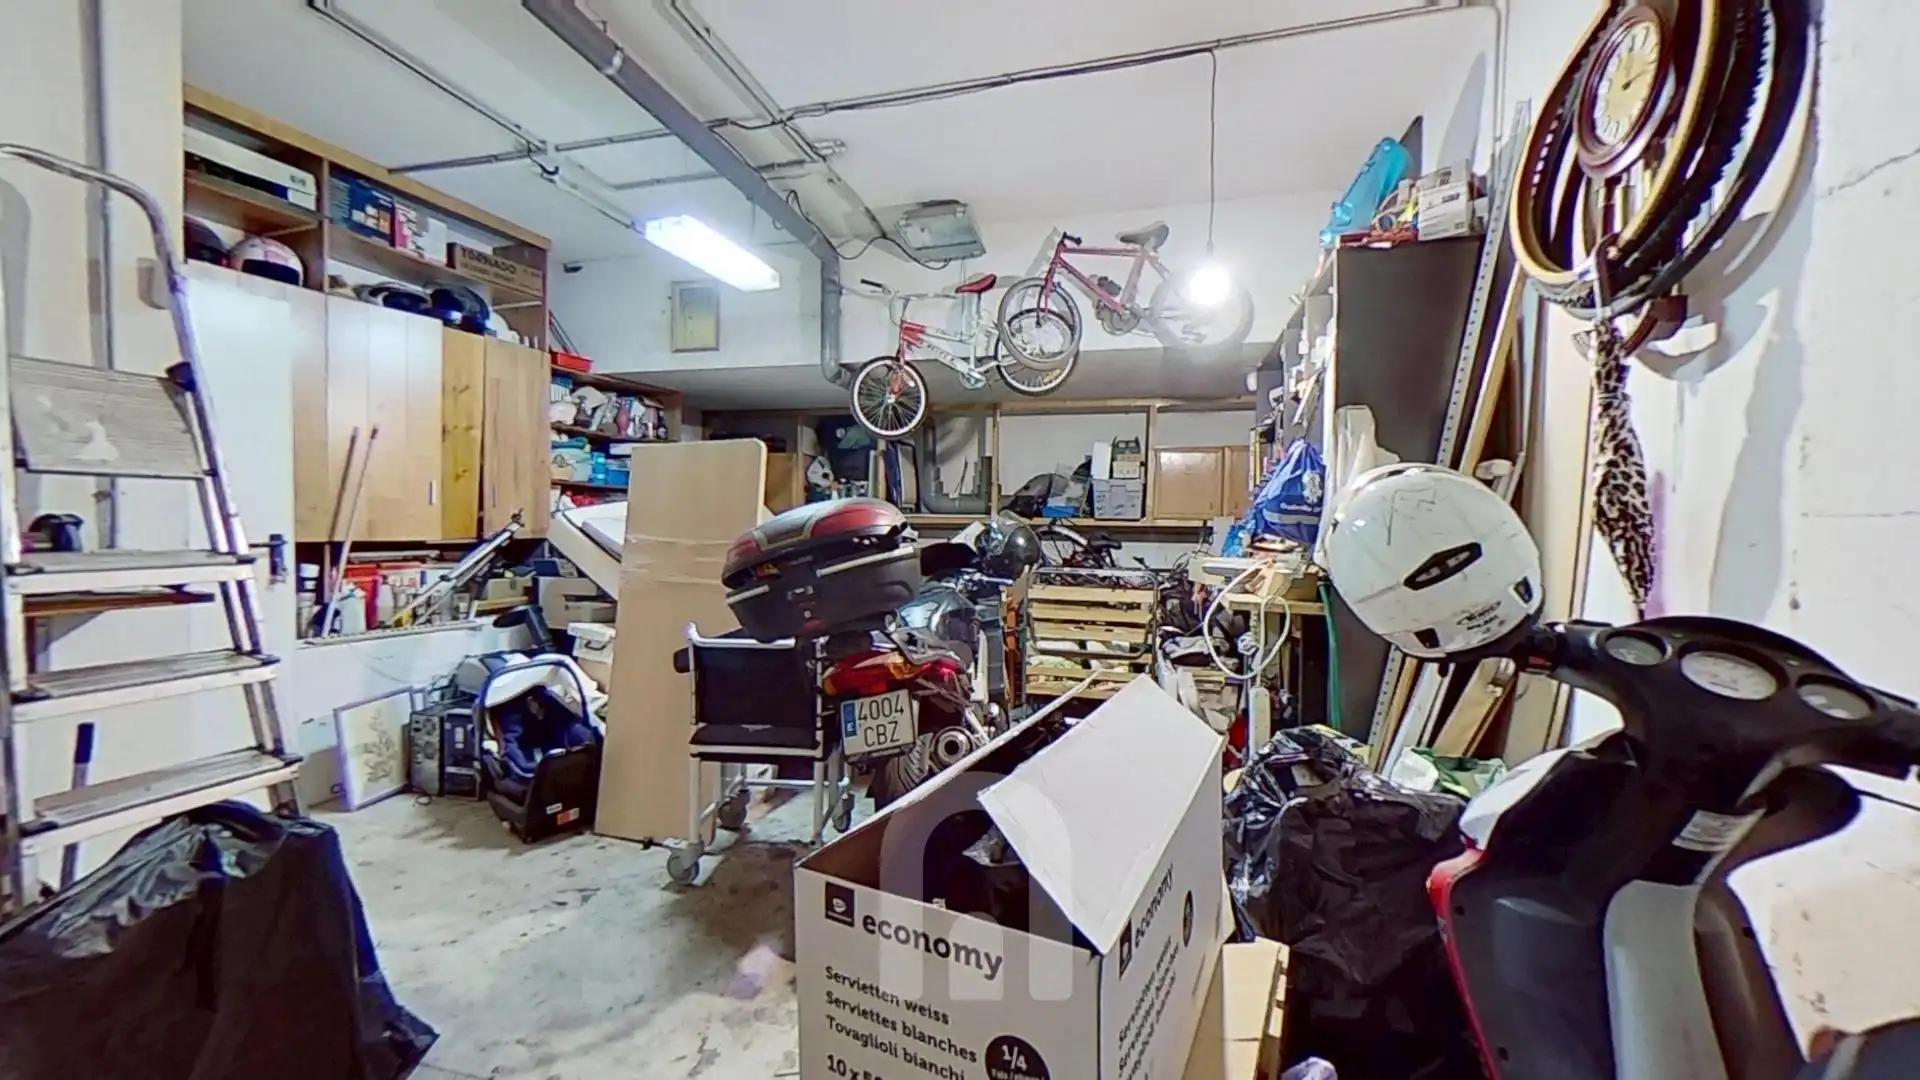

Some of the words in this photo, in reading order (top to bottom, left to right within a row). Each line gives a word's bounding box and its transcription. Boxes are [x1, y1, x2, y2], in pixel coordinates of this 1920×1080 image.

[858, 694, 904, 721] 4004
[863, 721, 900, 748] CBZ
[862, 914, 1003, 981] economy
[825, 965, 900, 1008] Servietten
[904, 1000, 950, 1025] weiss
[825, 990, 898, 1032] Serviettes
[902, 1021, 977, 1063] blanches
[826, 1014, 899, 1059] Tovaglioli
[903, 1047, 965, 1080] bianchi
[827, 1054, 847, 1077] 10
[1001, 1044, 1028, 1072] 1/4
